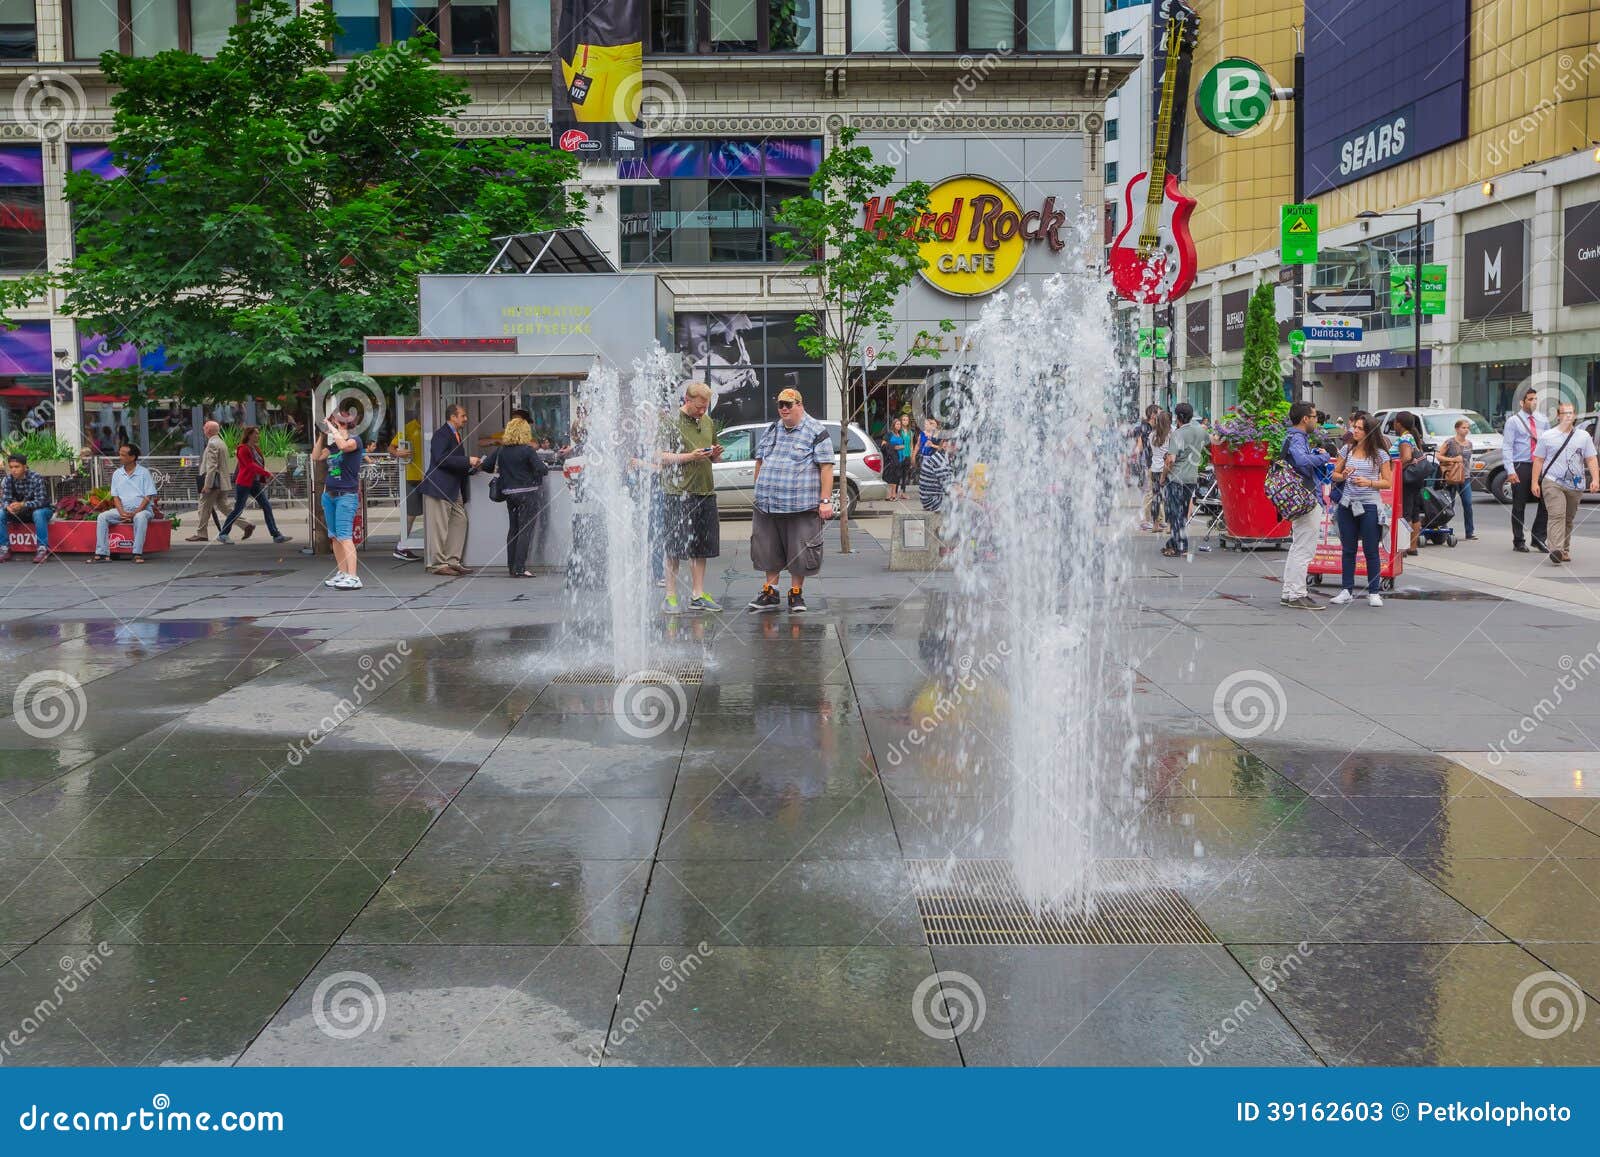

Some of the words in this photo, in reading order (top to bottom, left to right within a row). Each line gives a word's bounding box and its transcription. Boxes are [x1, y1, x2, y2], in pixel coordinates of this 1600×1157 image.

[571, 86, 586, 99] VIP
[1217, 67, 1260, 113] P
[1340, 117, 1406, 176] SEARS
[1287, 207, 1314, 215] NOTICE
[970, 194, 1066, 250] Rock
[1578, 247, 1596, 260] Calvin
[937, 253, 995, 274] CAFE
[1484, 246, 1502, 291] M
[502, 305, 591, 317] INFORMATION
[1226, 311, 1245, 325] BUFFALO
[503, 323, 592, 335] SIGHTSEEING
[1311, 328, 1344, 338] Dundas
[1346, 330, 1355, 340] Sq
[1356, 353, 1381, 368] SEARS
[9, 533, 38, 545] COZY
